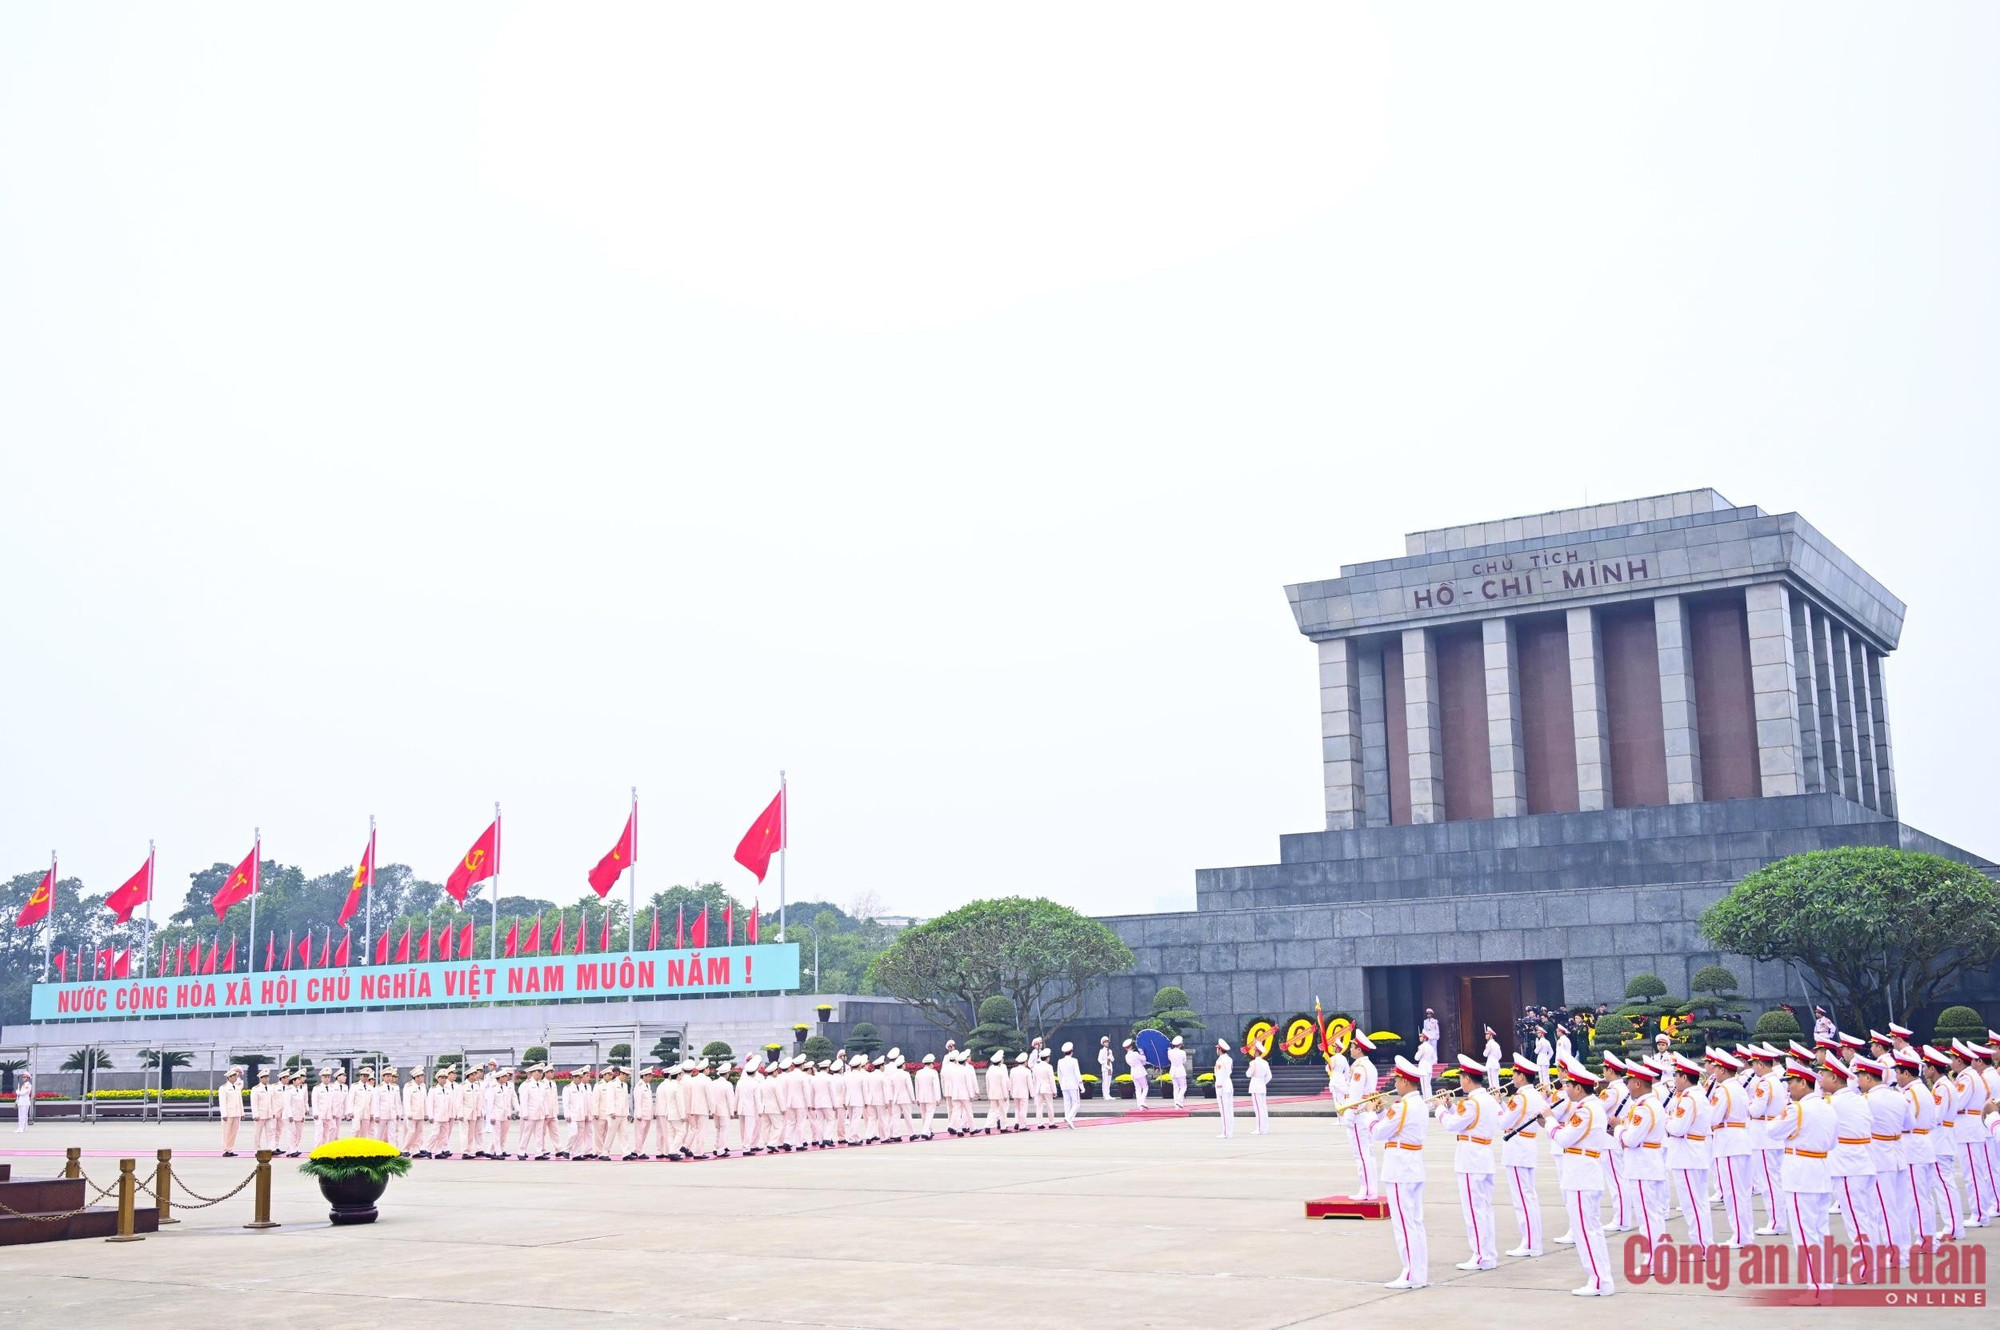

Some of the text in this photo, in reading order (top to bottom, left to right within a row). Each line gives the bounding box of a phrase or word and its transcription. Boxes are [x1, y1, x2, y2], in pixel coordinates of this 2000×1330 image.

[1472, 554, 1513, 575] CHỦ
[1414, 581, 1455, 609] HỒ
[1481, 569, 1533, 600] CHÍ
[57, 986, 107, 1013] NƯỚC
[115, 983, 167, 1014] CỘNG
[176, 979, 216, 1009] HÒA
[225, 977, 252, 1006] XÃ
[261, 974, 297, 1008] HỘI
[306, 968, 351, 1002] CHỦ
[360, 966, 431, 1000] NGHĨA
[444, 964, 496, 1000] VIỆT
[508, 965, 564, 994] NAM
[576, 956, 655, 991] MUÔN
[667, 953, 730, 987] NĂM
